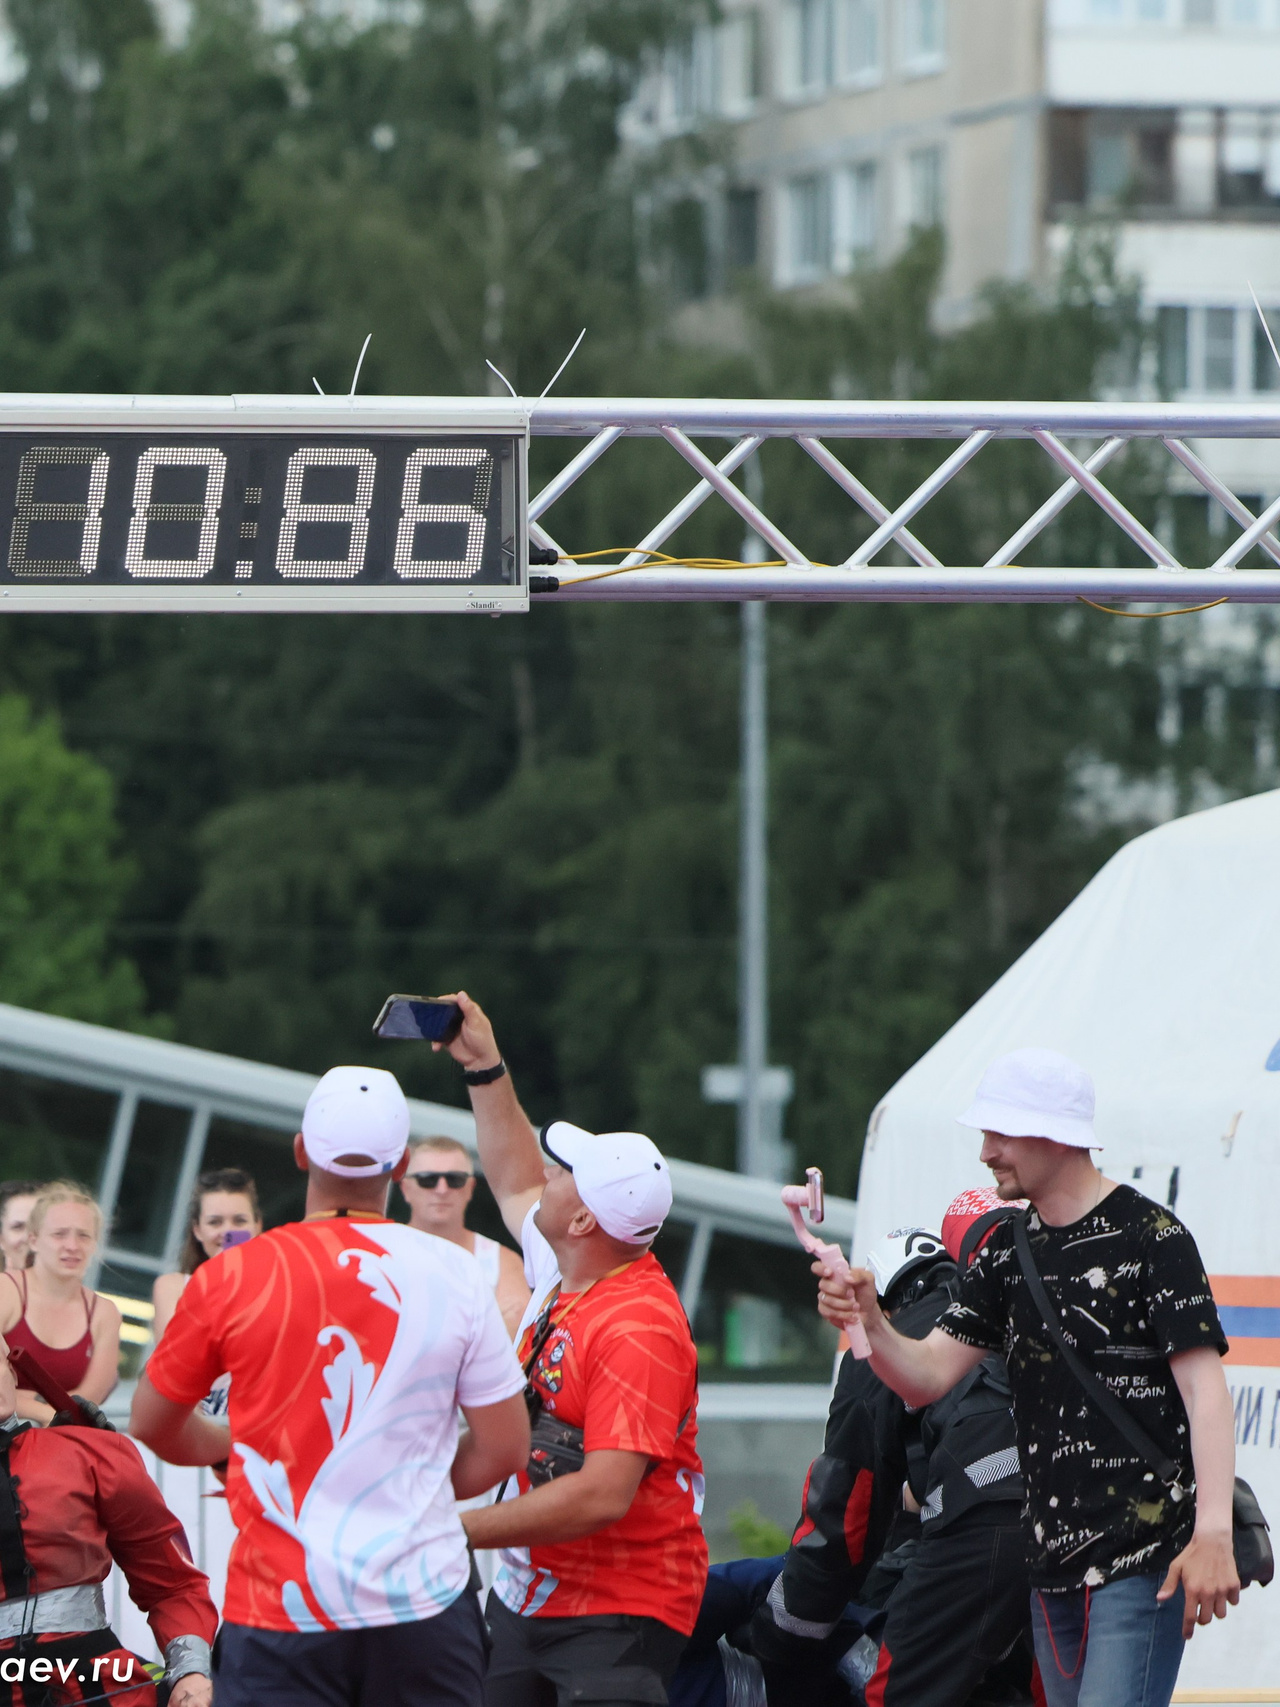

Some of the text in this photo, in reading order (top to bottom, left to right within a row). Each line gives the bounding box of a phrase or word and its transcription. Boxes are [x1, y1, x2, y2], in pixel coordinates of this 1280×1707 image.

[1155, 1224, 1184, 1242] COOL
[1132, 1375, 1149, 1387] BE
[1126, 1385, 1166, 1399] AGAIN
